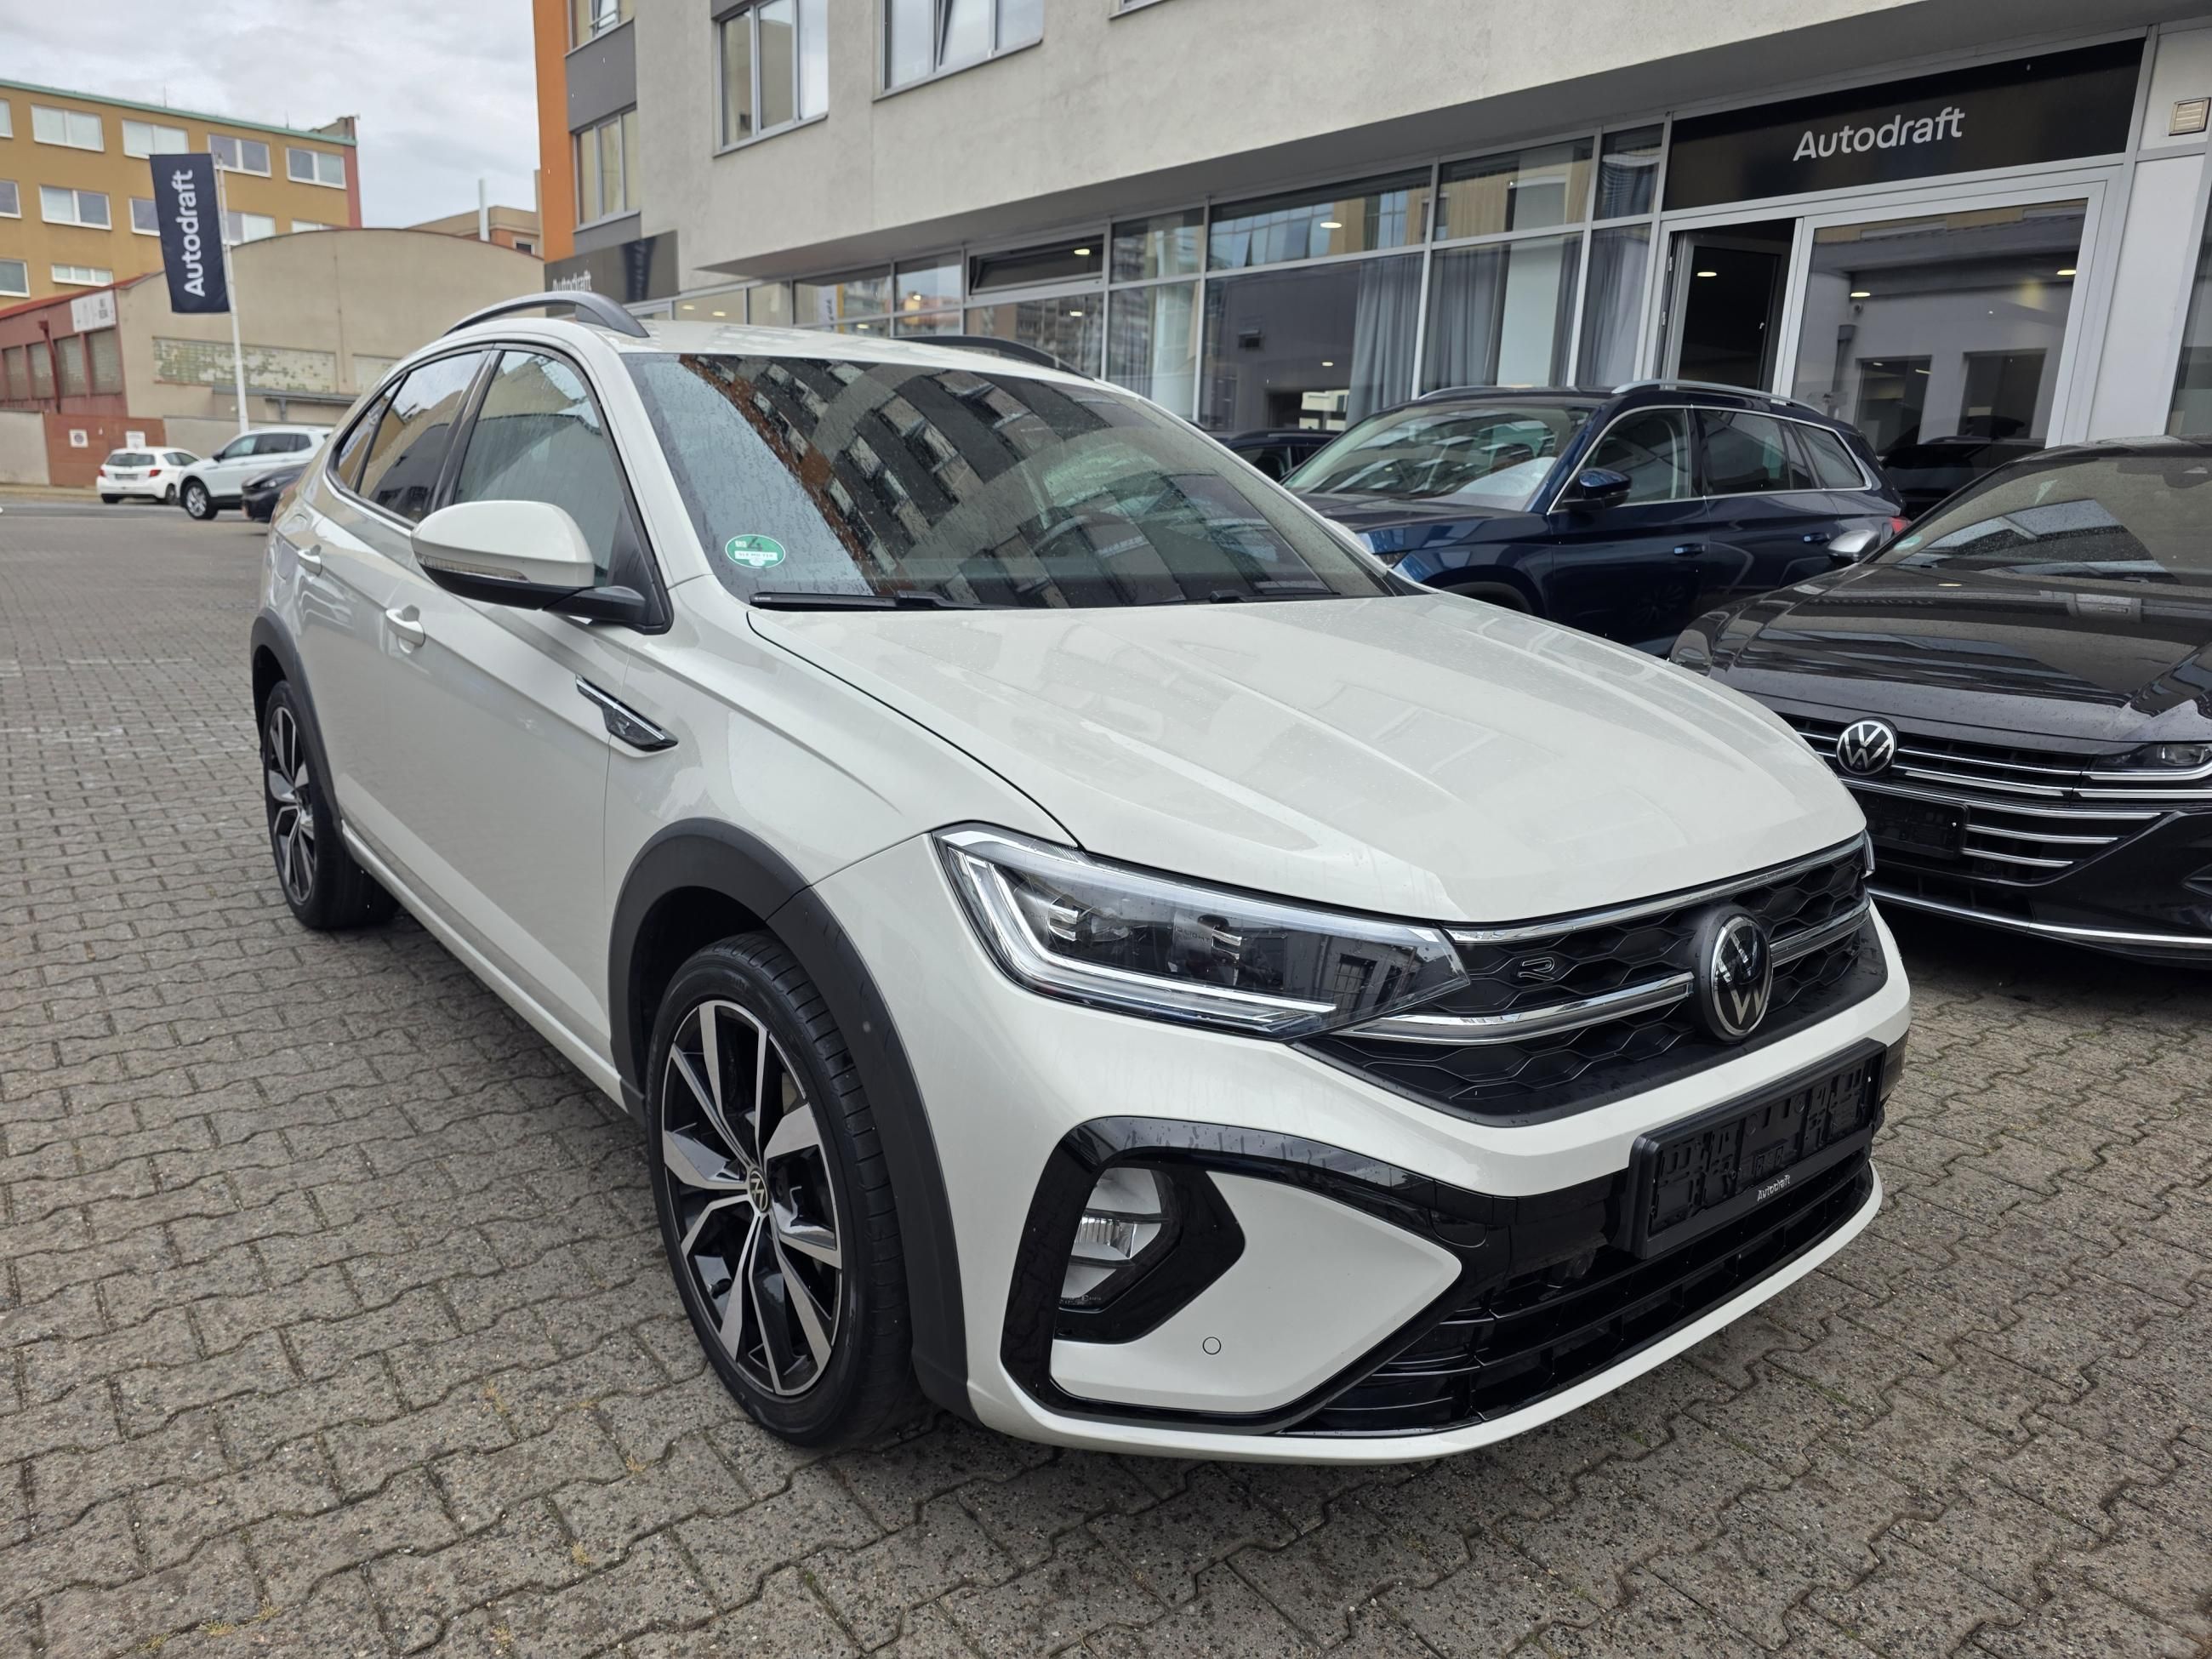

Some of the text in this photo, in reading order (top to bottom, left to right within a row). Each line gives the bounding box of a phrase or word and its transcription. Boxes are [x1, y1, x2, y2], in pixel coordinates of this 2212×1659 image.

[1793, 106, 1965, 162] Autodraft
[171, 169, 206, 297] Autodraft
[1519, 956, 1555, 981] R
